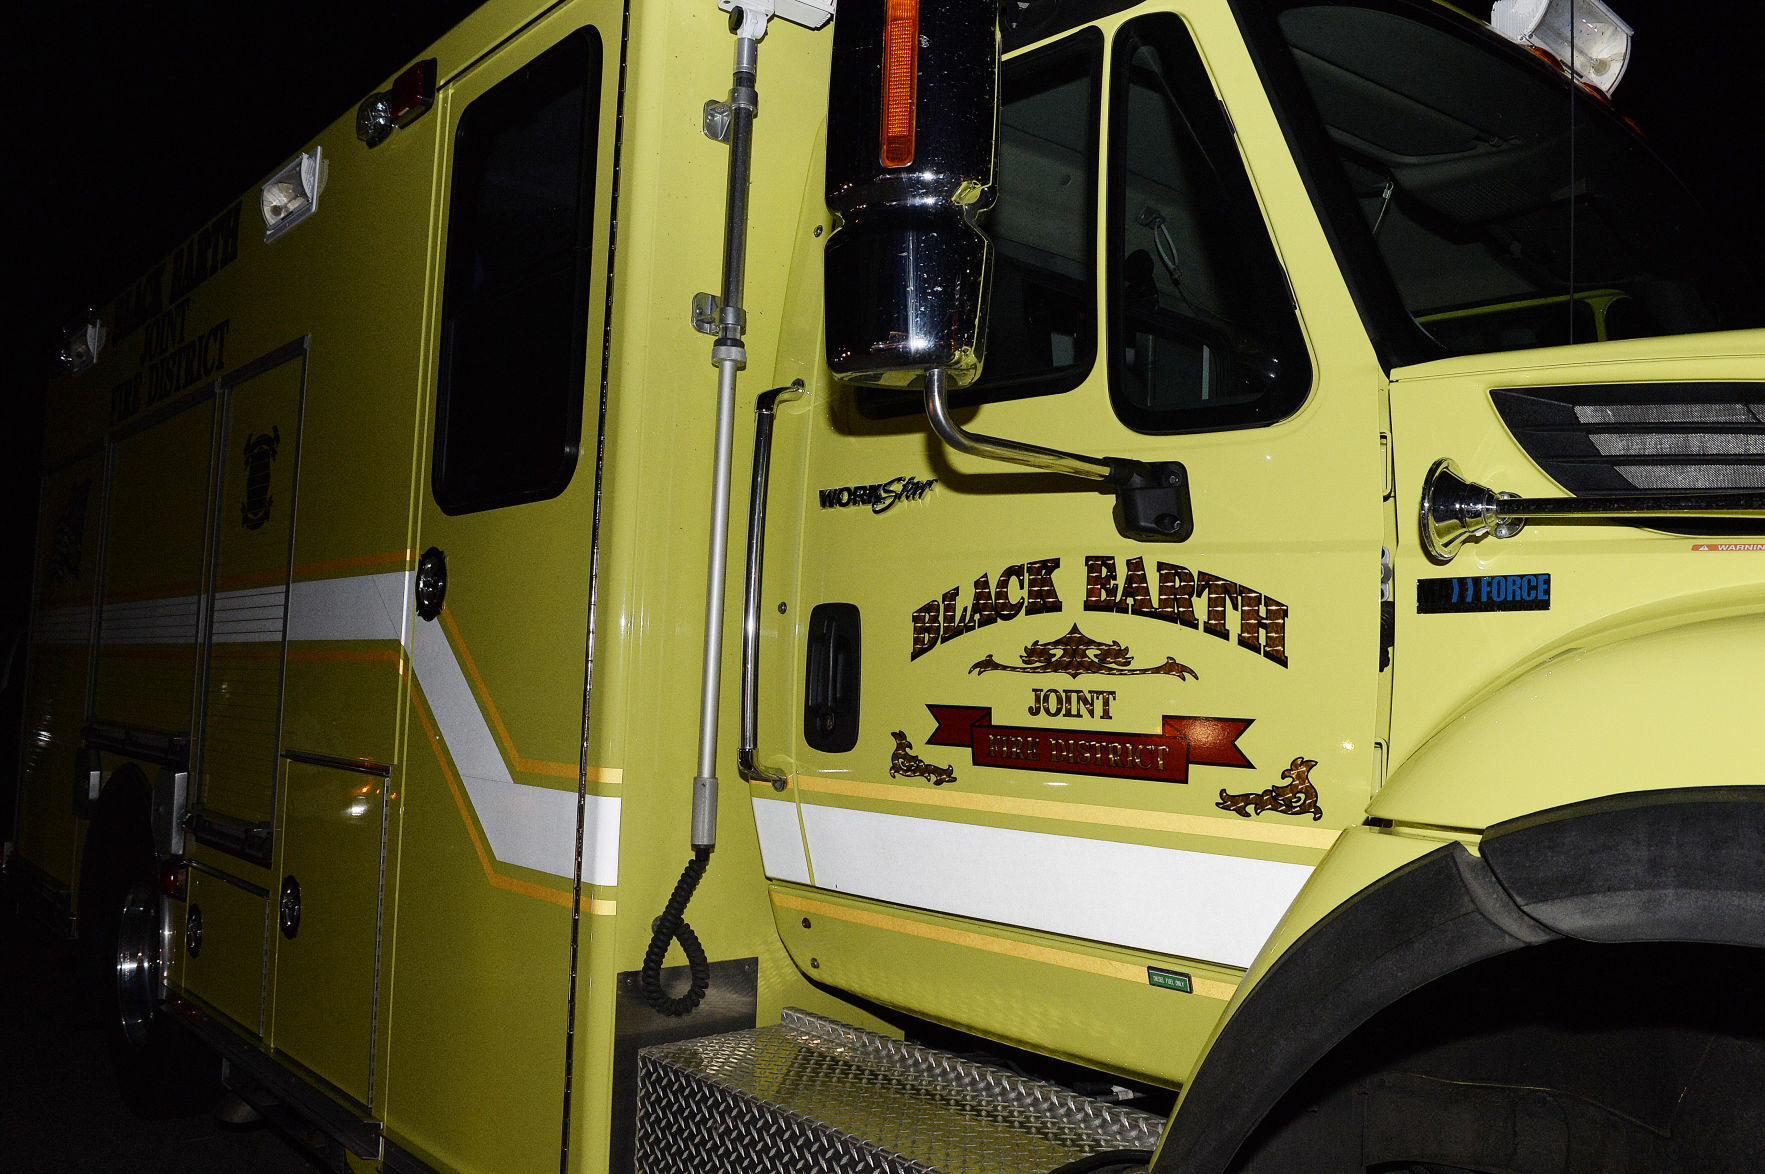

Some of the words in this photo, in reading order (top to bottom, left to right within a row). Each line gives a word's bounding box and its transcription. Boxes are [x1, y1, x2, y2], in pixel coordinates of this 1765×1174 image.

[140, 297, 191, 368] JOINT
[110, 372, 143, 426] FIRE
[146, 319, 230, 407] DISTRICT
[911, 557, 1063, 662] BLACK
[1083, 555, 1289, 669] EARTH
[1480, 574, 1549, 602] FORCE
[1027, 688, 1116, 720] JOINT
[988, 733, 1041, 761] FIRE
[1049, 736, 1170, 772] DISTRICT
